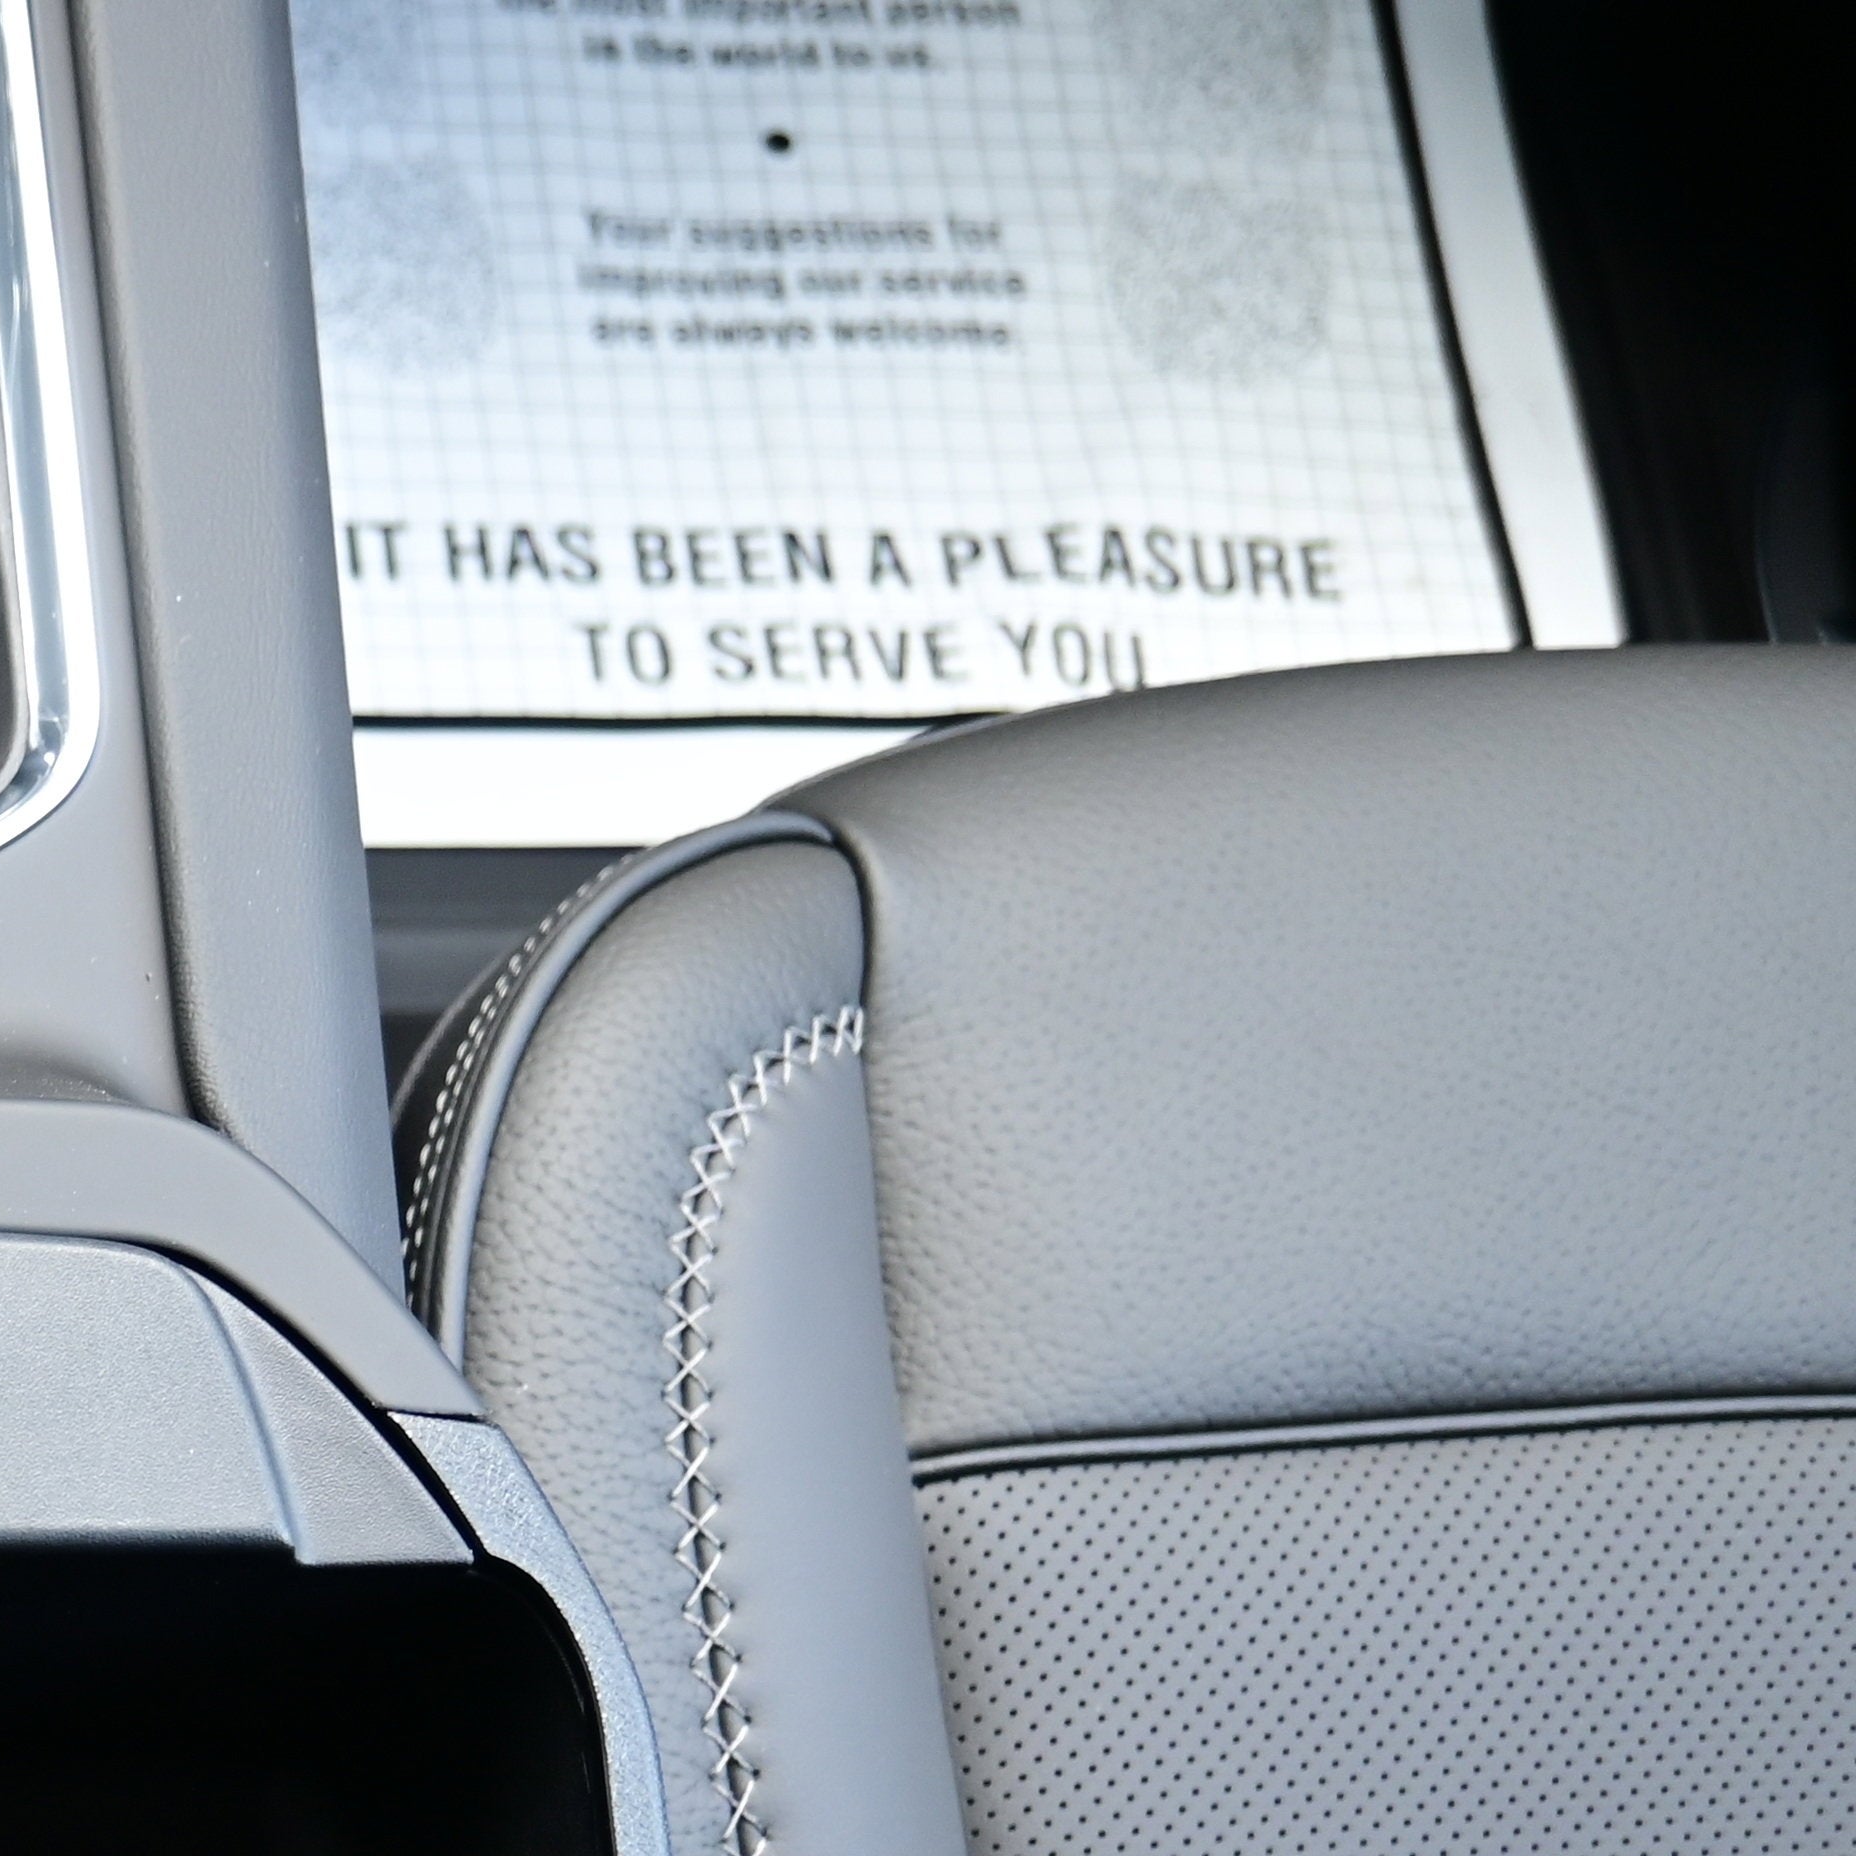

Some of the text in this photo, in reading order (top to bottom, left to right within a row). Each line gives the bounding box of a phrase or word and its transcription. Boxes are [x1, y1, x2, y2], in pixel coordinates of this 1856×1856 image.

[633, 36, 695, 66] the
[712, 40, 819, 69] world
[831, 41, 872, 69] to
[586, 210, 1003, 252] Your suggestions for
[577, 261, 1027, 304] improving our service
[592, 318, 653, 344] are
[671, 315, 814, 350] always
[344, 521, 1343, 601] IT HAS BEEN A PLEASURE
[581, 619, 1148, 693] TO SERVE YOU
